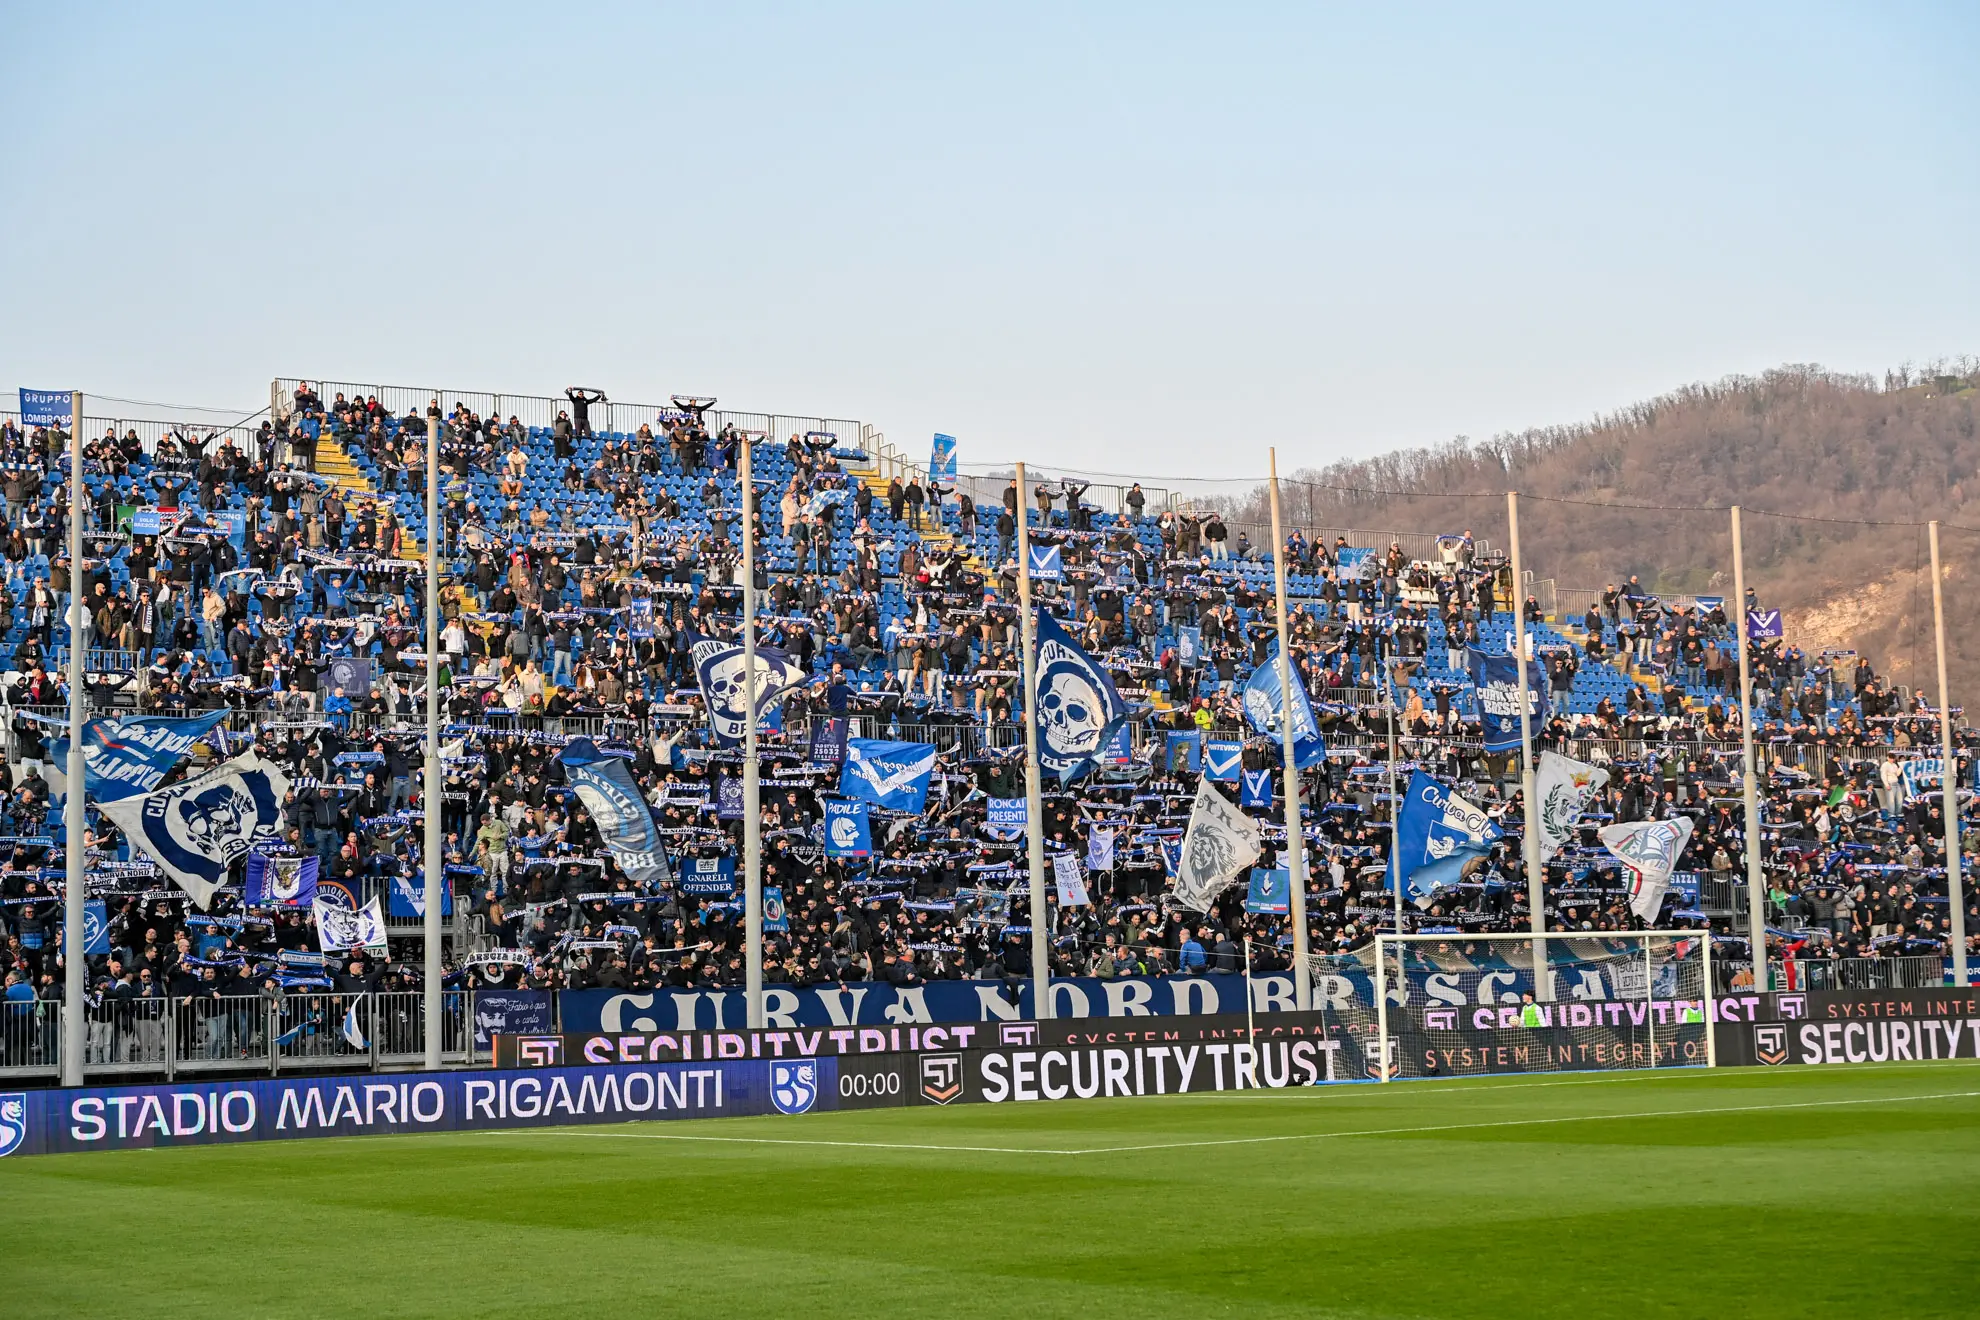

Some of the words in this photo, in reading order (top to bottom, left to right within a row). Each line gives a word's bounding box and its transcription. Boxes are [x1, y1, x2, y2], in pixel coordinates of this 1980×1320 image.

[24, 393, 70, 403] GRUPPO
[23, 413, 73, 425] LOMBROSO
[1484, 700, 1536, 715] BRESCA
[988, 798, 1026, 809] RONCAI
[988, 811, 1027, 822] PRESENTI
[1421, 785, 1466, 822] Curva
[1466, 813, 1498, 839] Nor
[687, 872, 728, 882] GNARÉLI
[683, 882, 732, 892] OFFENDER
[1424, 1046, 1530, 1069] SYSTEM
[839, 1072, 900, 1098] 00:00
[71, 1090, 257, 1141] STADIO
[276, 1083, 444, 1130] MARIO
[464, 1069, 723, 1121] RIGAMONTI
